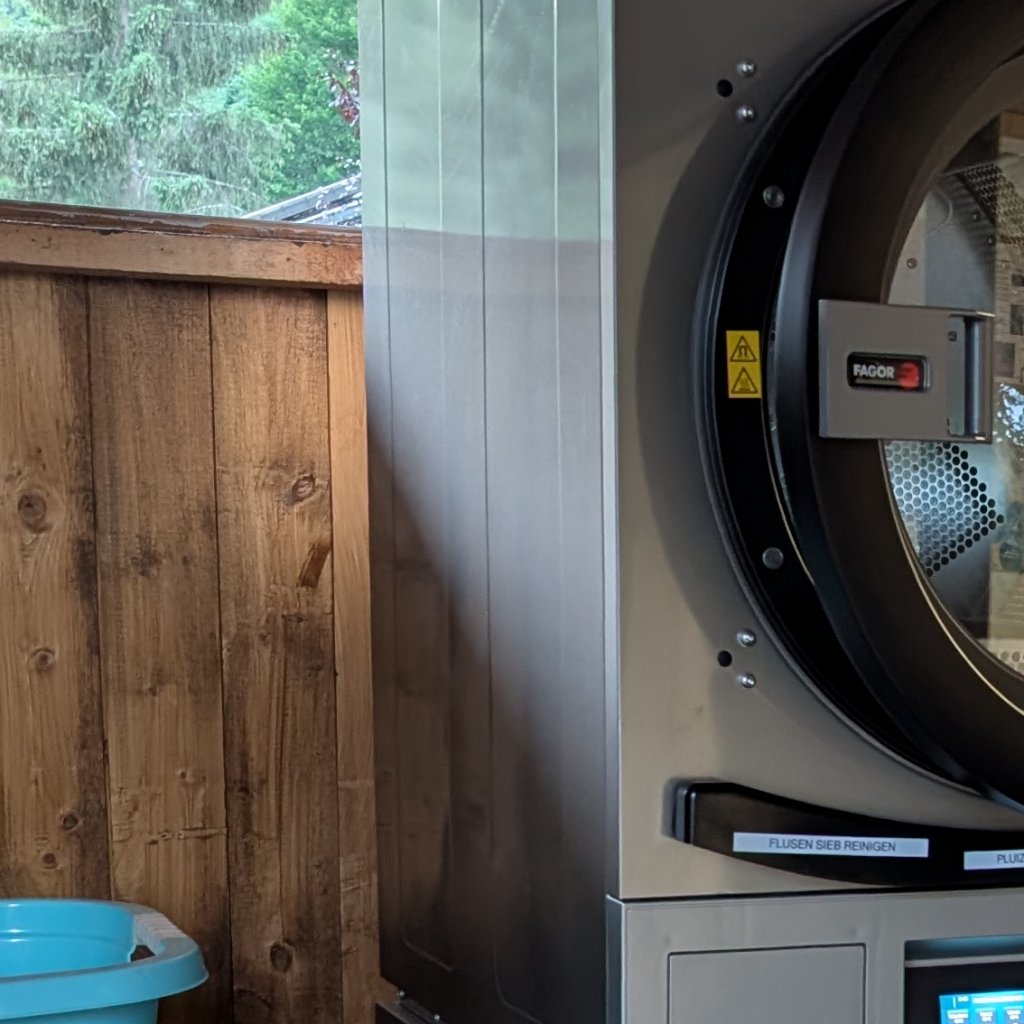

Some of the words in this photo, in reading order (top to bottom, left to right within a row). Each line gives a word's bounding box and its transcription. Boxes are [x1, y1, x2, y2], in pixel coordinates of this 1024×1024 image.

[853, 363, 895, 379] FAGOR
[769, 838, 813, 850] FLUSEN
[815, 839, 841, 850] SIEB
[843, 840, 896, 852] REINIGEN
